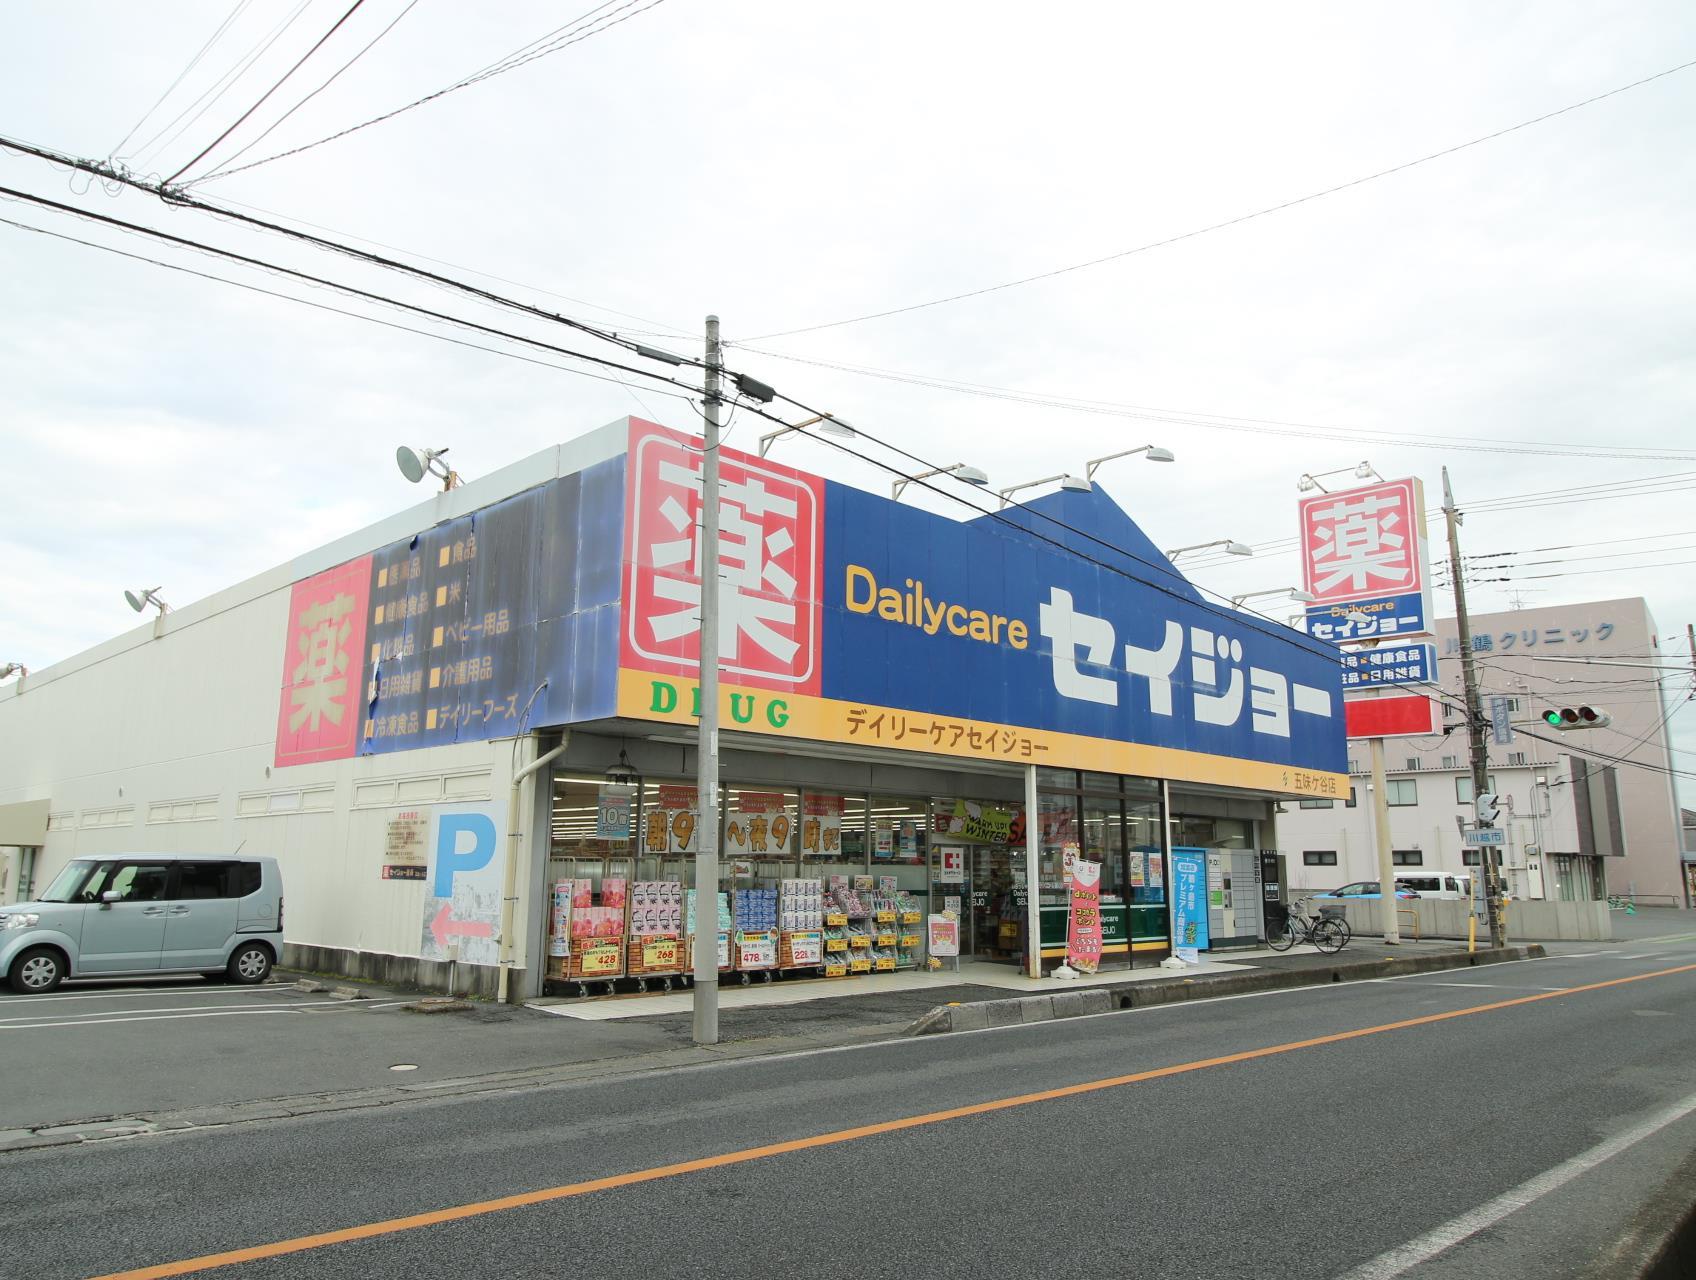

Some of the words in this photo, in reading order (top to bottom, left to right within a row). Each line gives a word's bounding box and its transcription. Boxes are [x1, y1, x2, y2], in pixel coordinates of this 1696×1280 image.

[453, 537, 477, 564] 食品
[1311, 496, 1411, 594] 薬
[647, 459, 801, 664] 薬
[449, 583, 461, 603] 米
[845, 564, 1029, 650] Dailycare
[445, 609, 510, 642] ベビー用品
[1311, 615, 1419, 640] セイジョー
[289, 592, 356, 733] 薬
[1040, 586, 1332, 738] セイジョー
[1369, 649, 1421, 665] 健康食品
[443, 656, 493, 688] 介護用品
[1370, 665, 1421, 681] 日用雑貨
[440, 693, 518, 728] デイリーフーズ
[375, 712, 419, 737] 冷凍食品
[846, 709, 1049, 758] デイリーケアセイジョー
[966, 823, 1007, 843] WINTER
[1468, 832, 1502, 843] 川越市
[434, 813, 497, 898] P
[598, 955, 616, 964] 428
[656, 950, 674, 959] 268
[743, 953, 760, 962] 478
